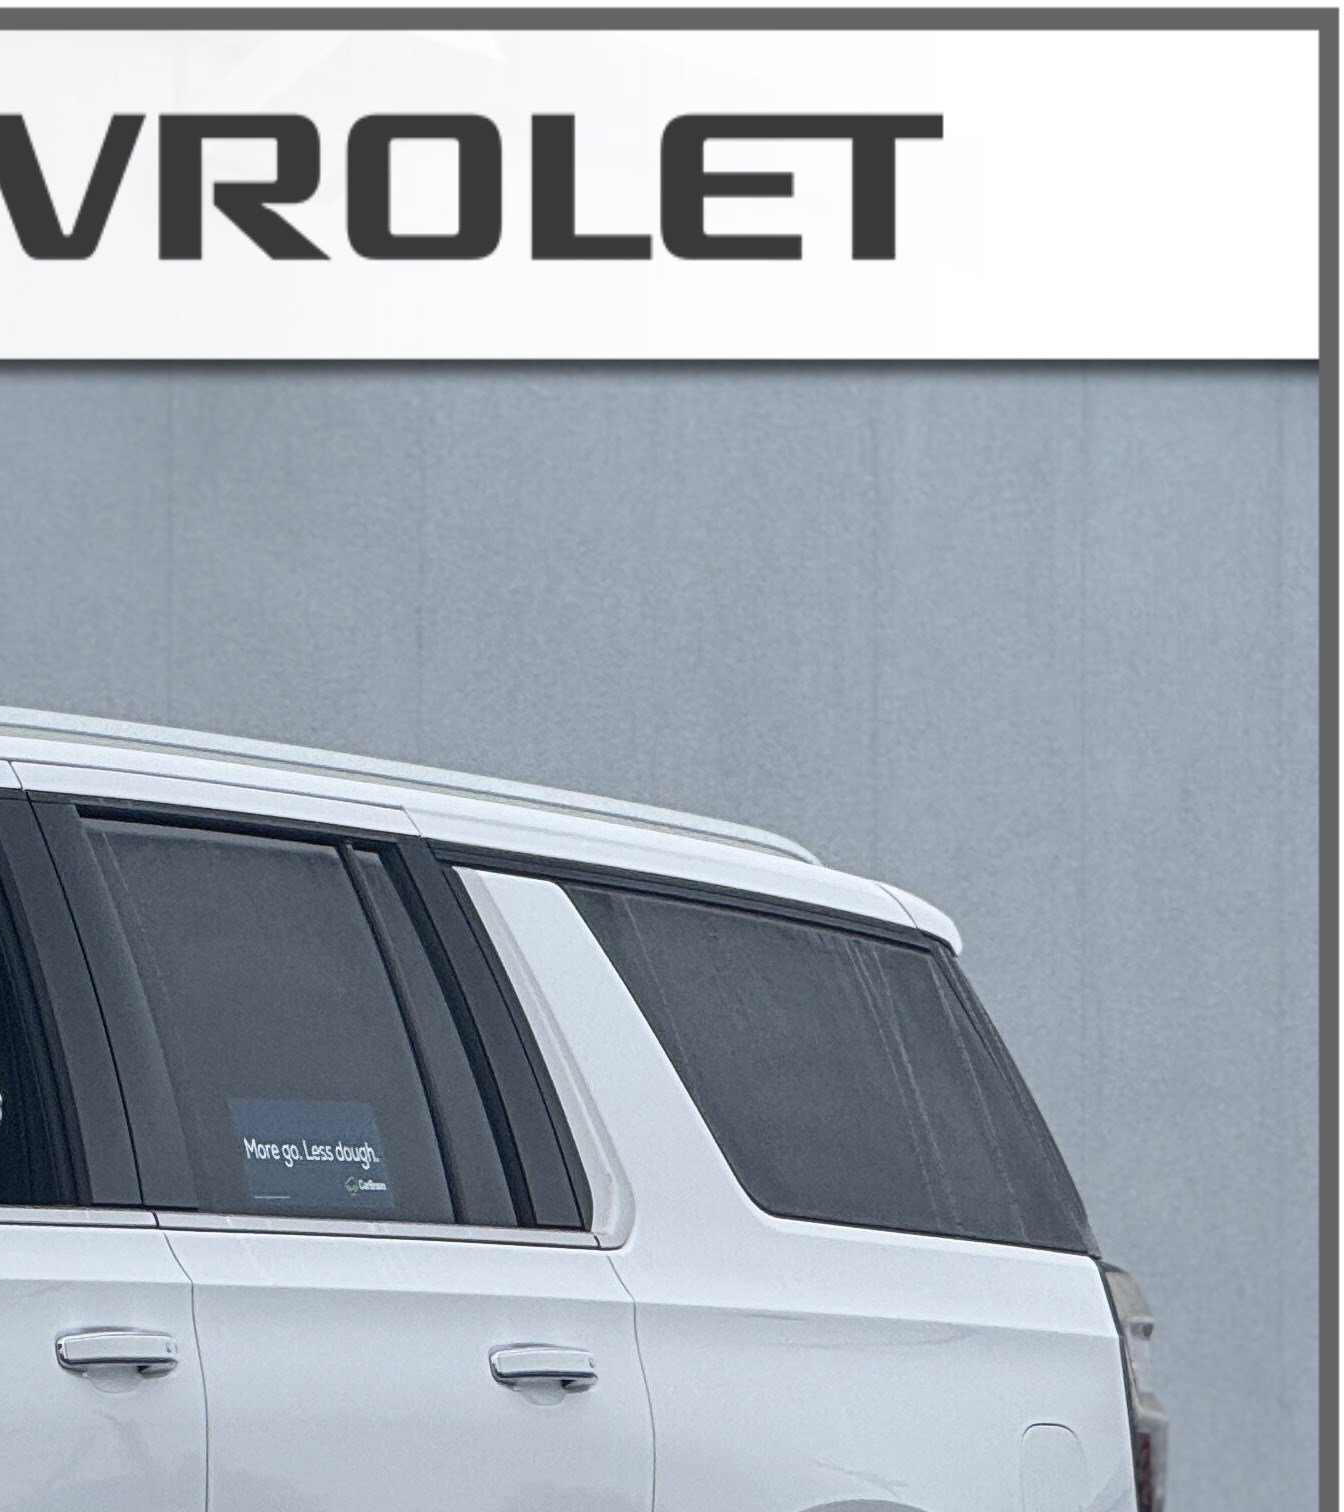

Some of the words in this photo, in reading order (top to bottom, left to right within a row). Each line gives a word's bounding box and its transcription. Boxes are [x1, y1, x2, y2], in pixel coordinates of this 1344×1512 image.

[244, 1137, 280, 1160] More
[282, 1143, 303, 1168] go.
[302, 1139, 335, 1162] Less
[335, 1140, 380, 1170] dough.
